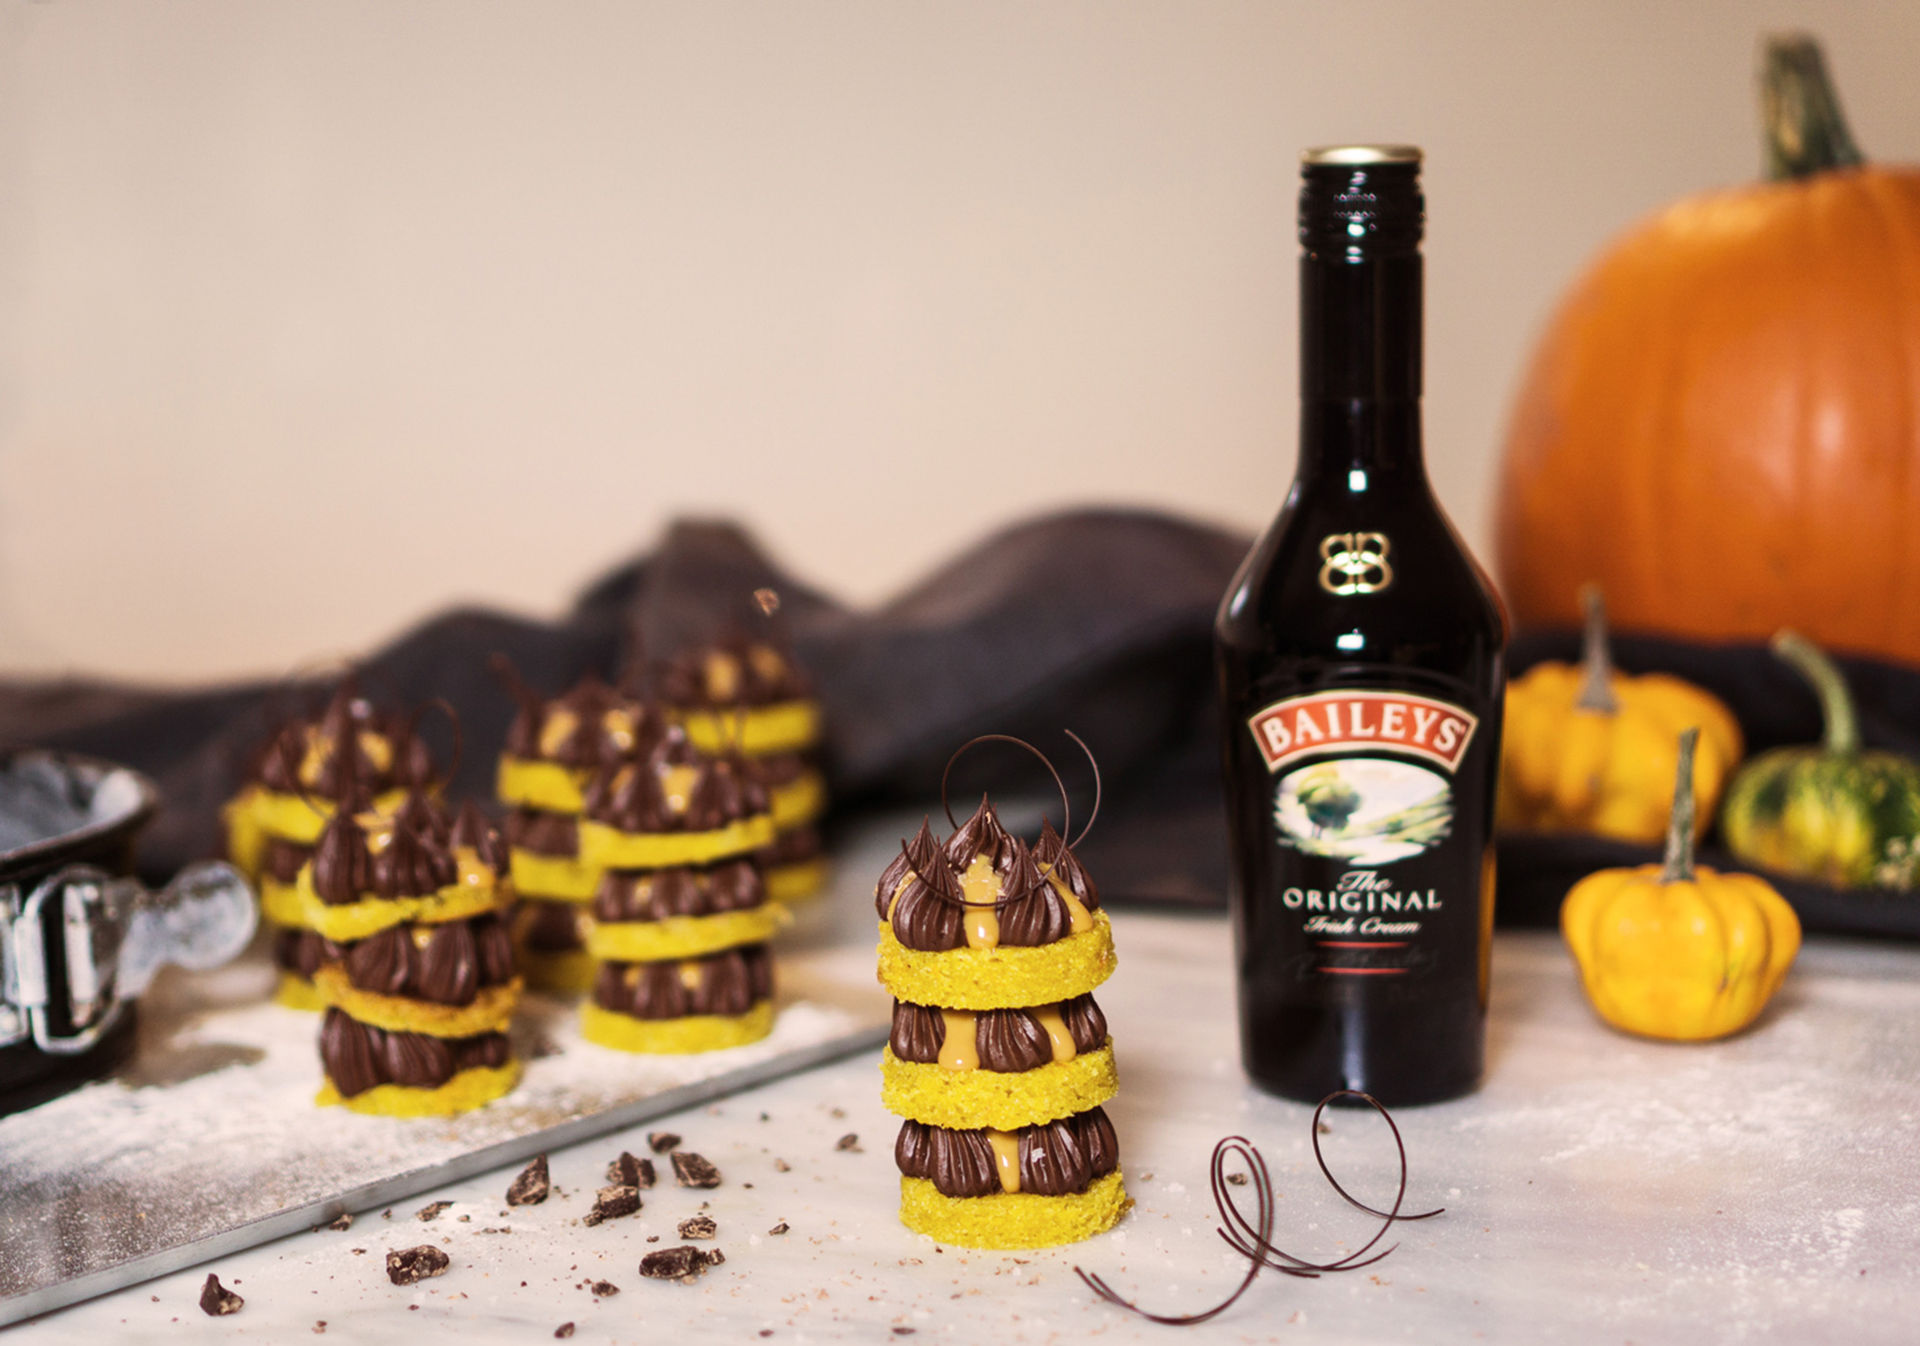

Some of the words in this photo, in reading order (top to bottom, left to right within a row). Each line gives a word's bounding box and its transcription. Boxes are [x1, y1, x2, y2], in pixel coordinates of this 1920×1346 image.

[1262, 702, 1462, 753] BAILEYS
[1336, 870, 1392, 891] The
[1283, 887, 1442, 911] ORIGINAL
[1360, 916, 1420, 934] Cream
